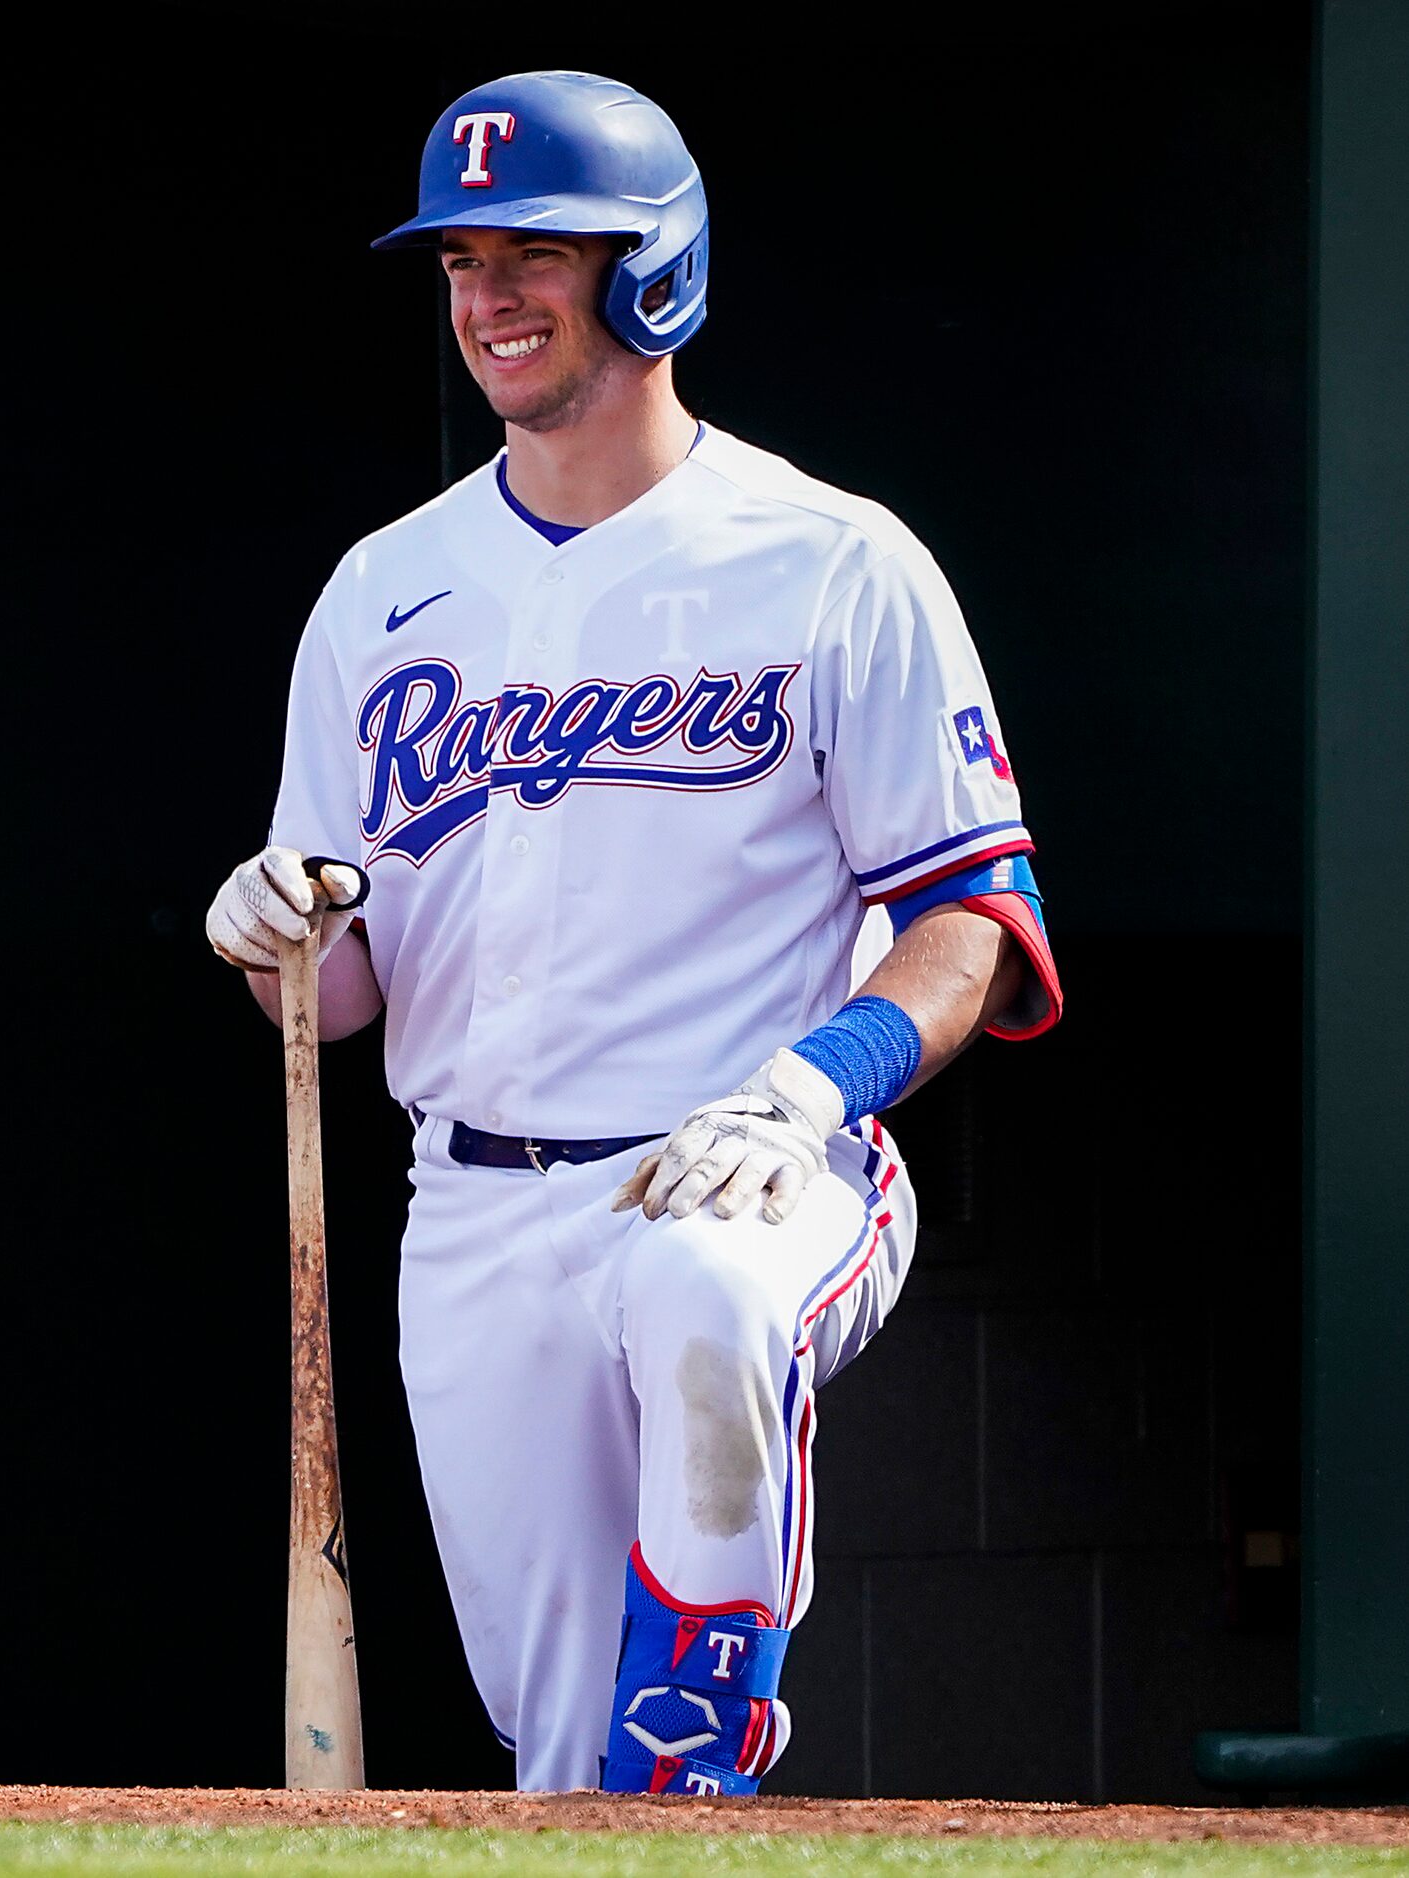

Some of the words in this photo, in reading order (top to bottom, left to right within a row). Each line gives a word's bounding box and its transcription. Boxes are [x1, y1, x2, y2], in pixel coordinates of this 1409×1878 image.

[453, 112, 515, 188] T
[357, 658, 802, 848] Rangers
[708, 1631, 746, 1681] T
